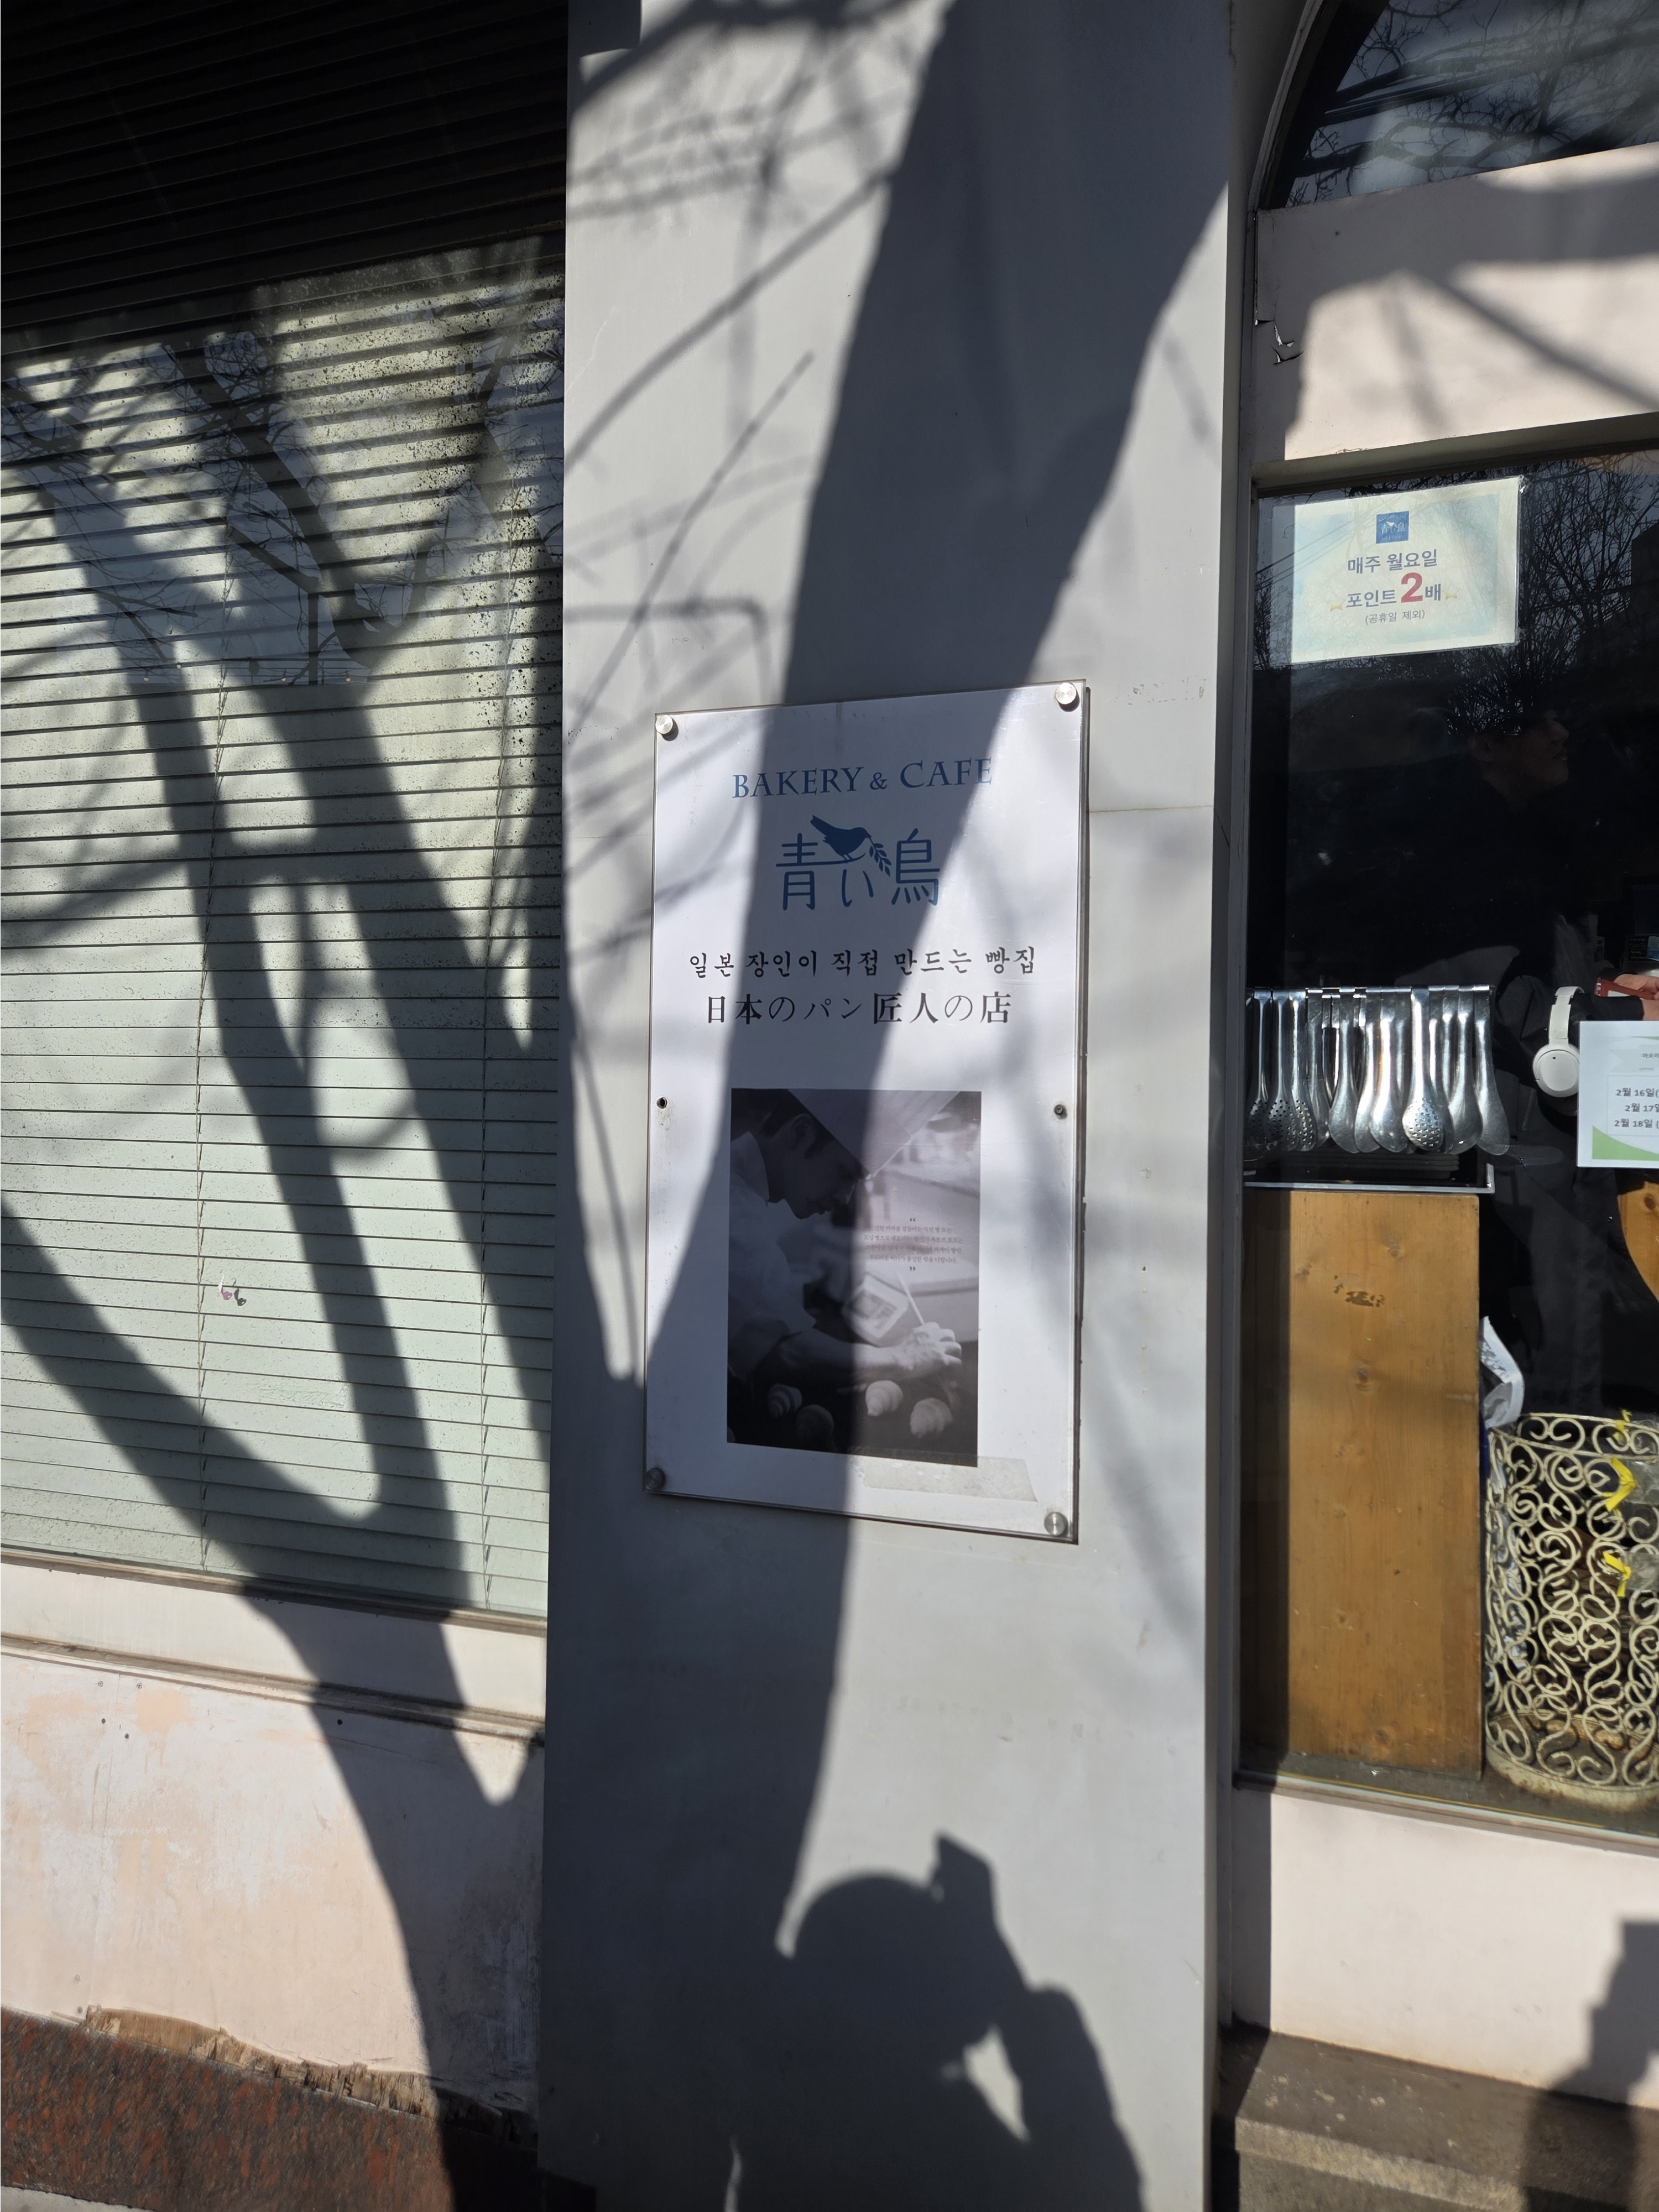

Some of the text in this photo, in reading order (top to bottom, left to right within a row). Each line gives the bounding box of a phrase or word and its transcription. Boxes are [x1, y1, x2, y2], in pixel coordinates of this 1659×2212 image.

[1348, 549, 1438, 574] 매주 월요일
[1346, 589, 1396, 609] 포인트
[1364, 609, 1425, 626] (공휴일 제외)
[732, 757, 993, 799] BAKERY & CAFE
[775, 827, 941, 911] 青い鳥
[689, 945, 1036, 978] 일본 장인이 직접 만드는 빵집
[707, 990, 1012, 1025] 日本のパン匠人の店
[1616, 1087, 1659, 1098] 2월 16일(
[1625, 1103, 1640, 1112] 2월
[1614, 1118, 1652, 1128] 2월 18일
